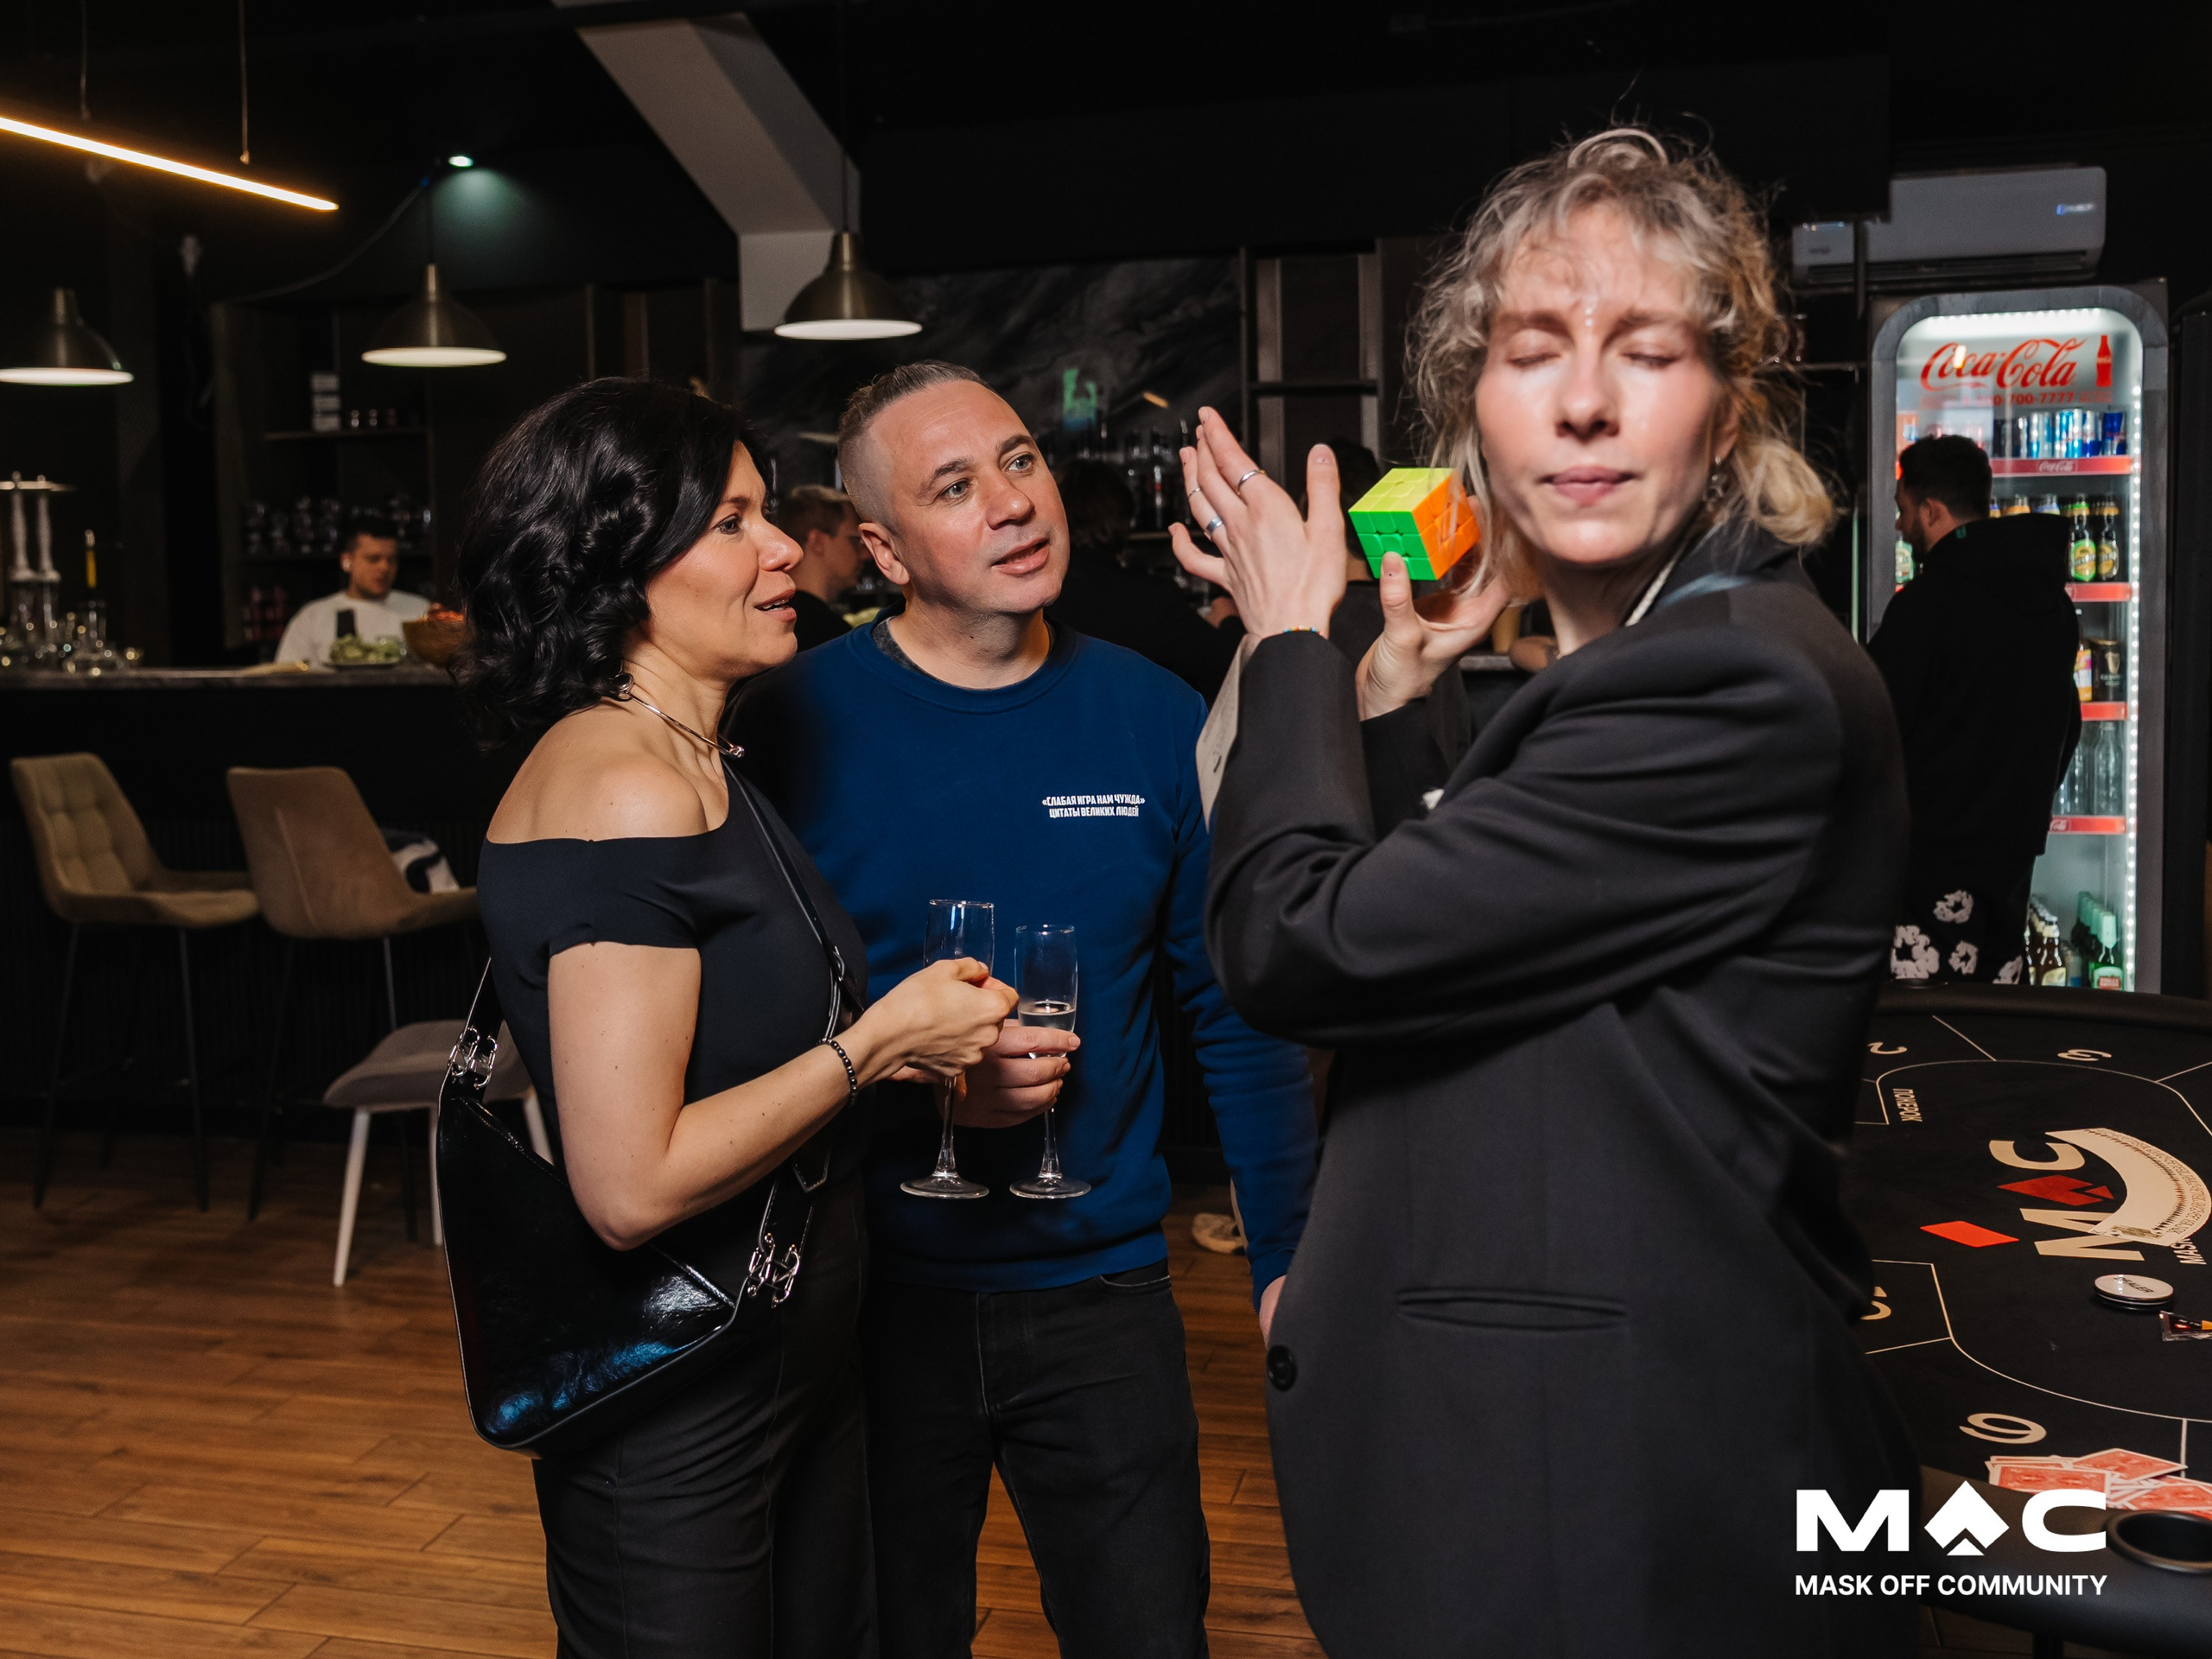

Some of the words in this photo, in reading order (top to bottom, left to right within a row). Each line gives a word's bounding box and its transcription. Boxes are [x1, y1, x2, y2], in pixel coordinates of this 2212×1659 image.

[1920, 338, 2085, 391] Coca-Cola
[1042, 796, 1077, 806] «СЛАБАЯ
[1077, 795, 1096, 805] ИГРА
[1096, 794, 1114, 804] НАМ
[1114, 793, 1146, 804] ЧУЖДА»
[1049, 807, 1081, 818] ЦИТАТЫ
[1080, 806, 1116, 817] ВЕЛИКИХ
